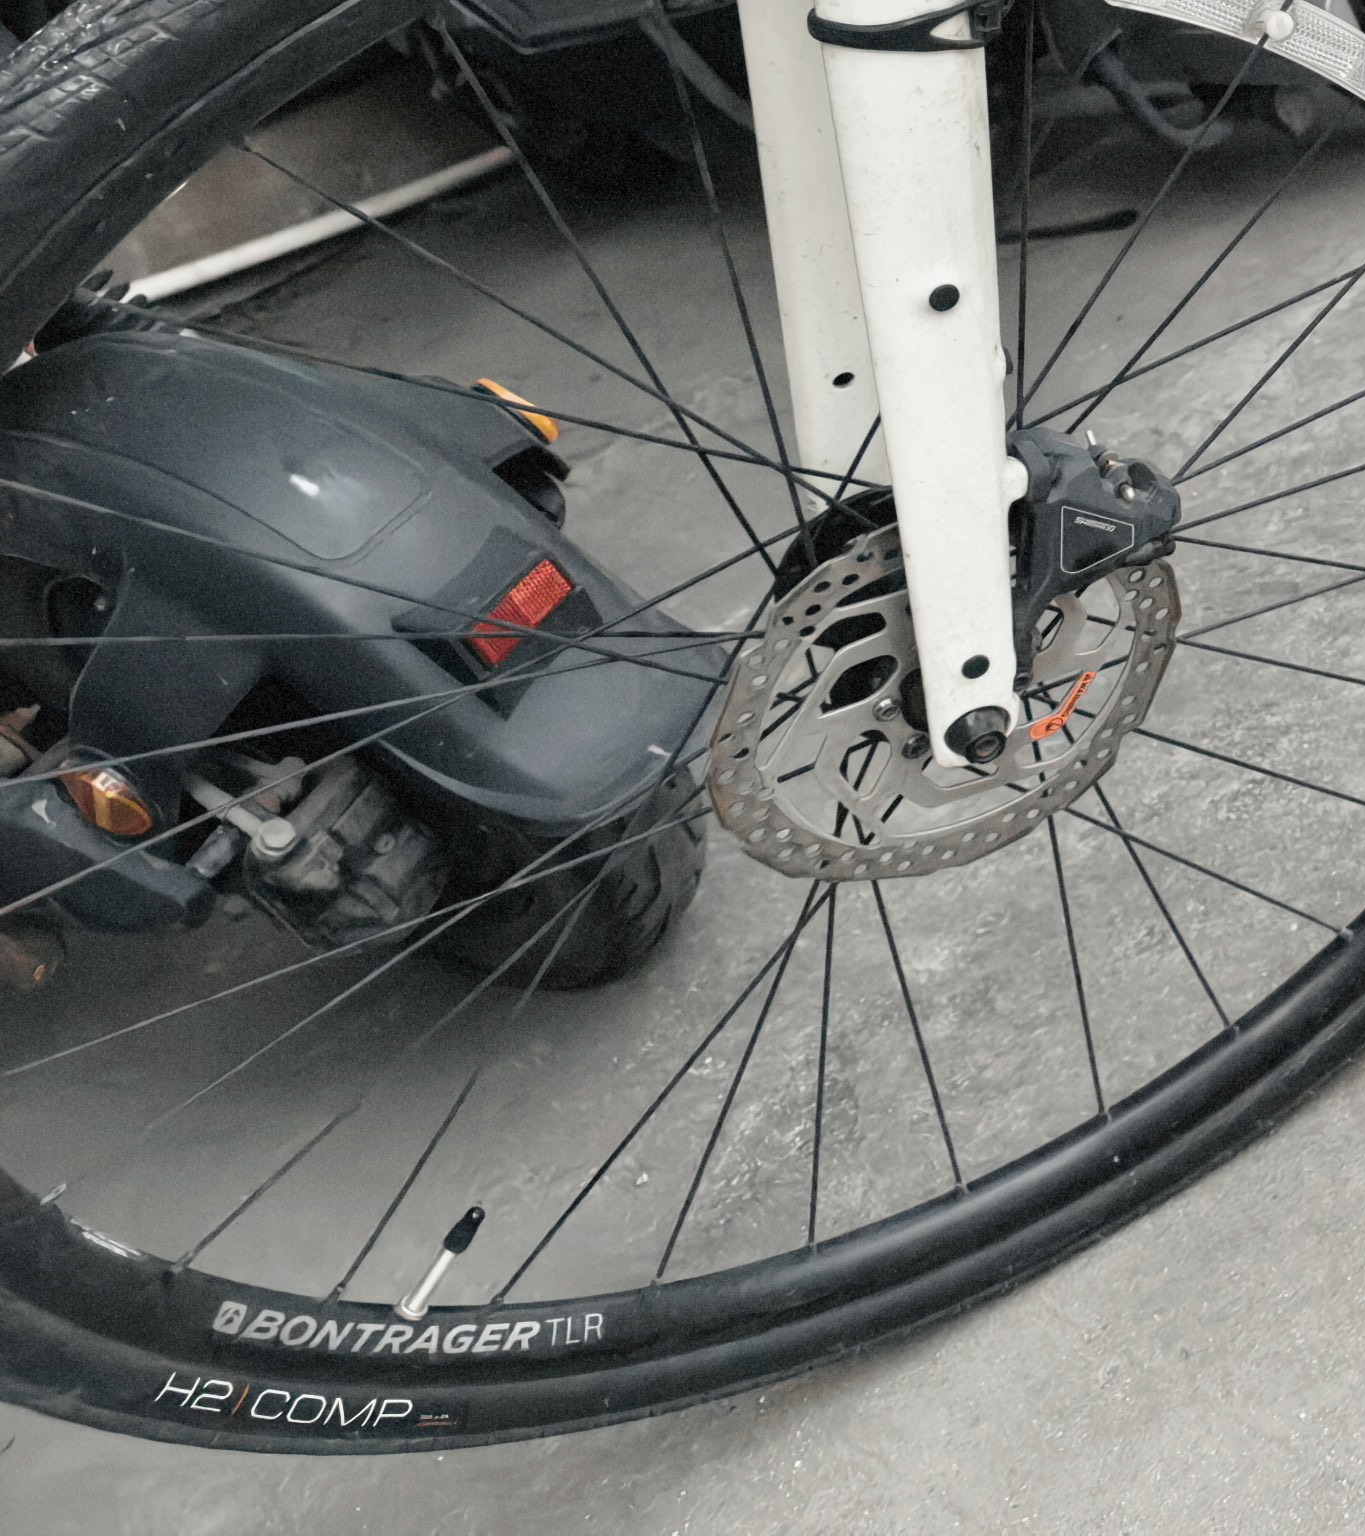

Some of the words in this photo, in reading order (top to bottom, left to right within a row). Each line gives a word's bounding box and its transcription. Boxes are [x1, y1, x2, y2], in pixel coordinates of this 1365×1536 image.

[241, 1308, 542, 1355] BONTRAGER
[544, 1311, 605, 1347] TLR
[250, 1388, 413, 1428] COMP
